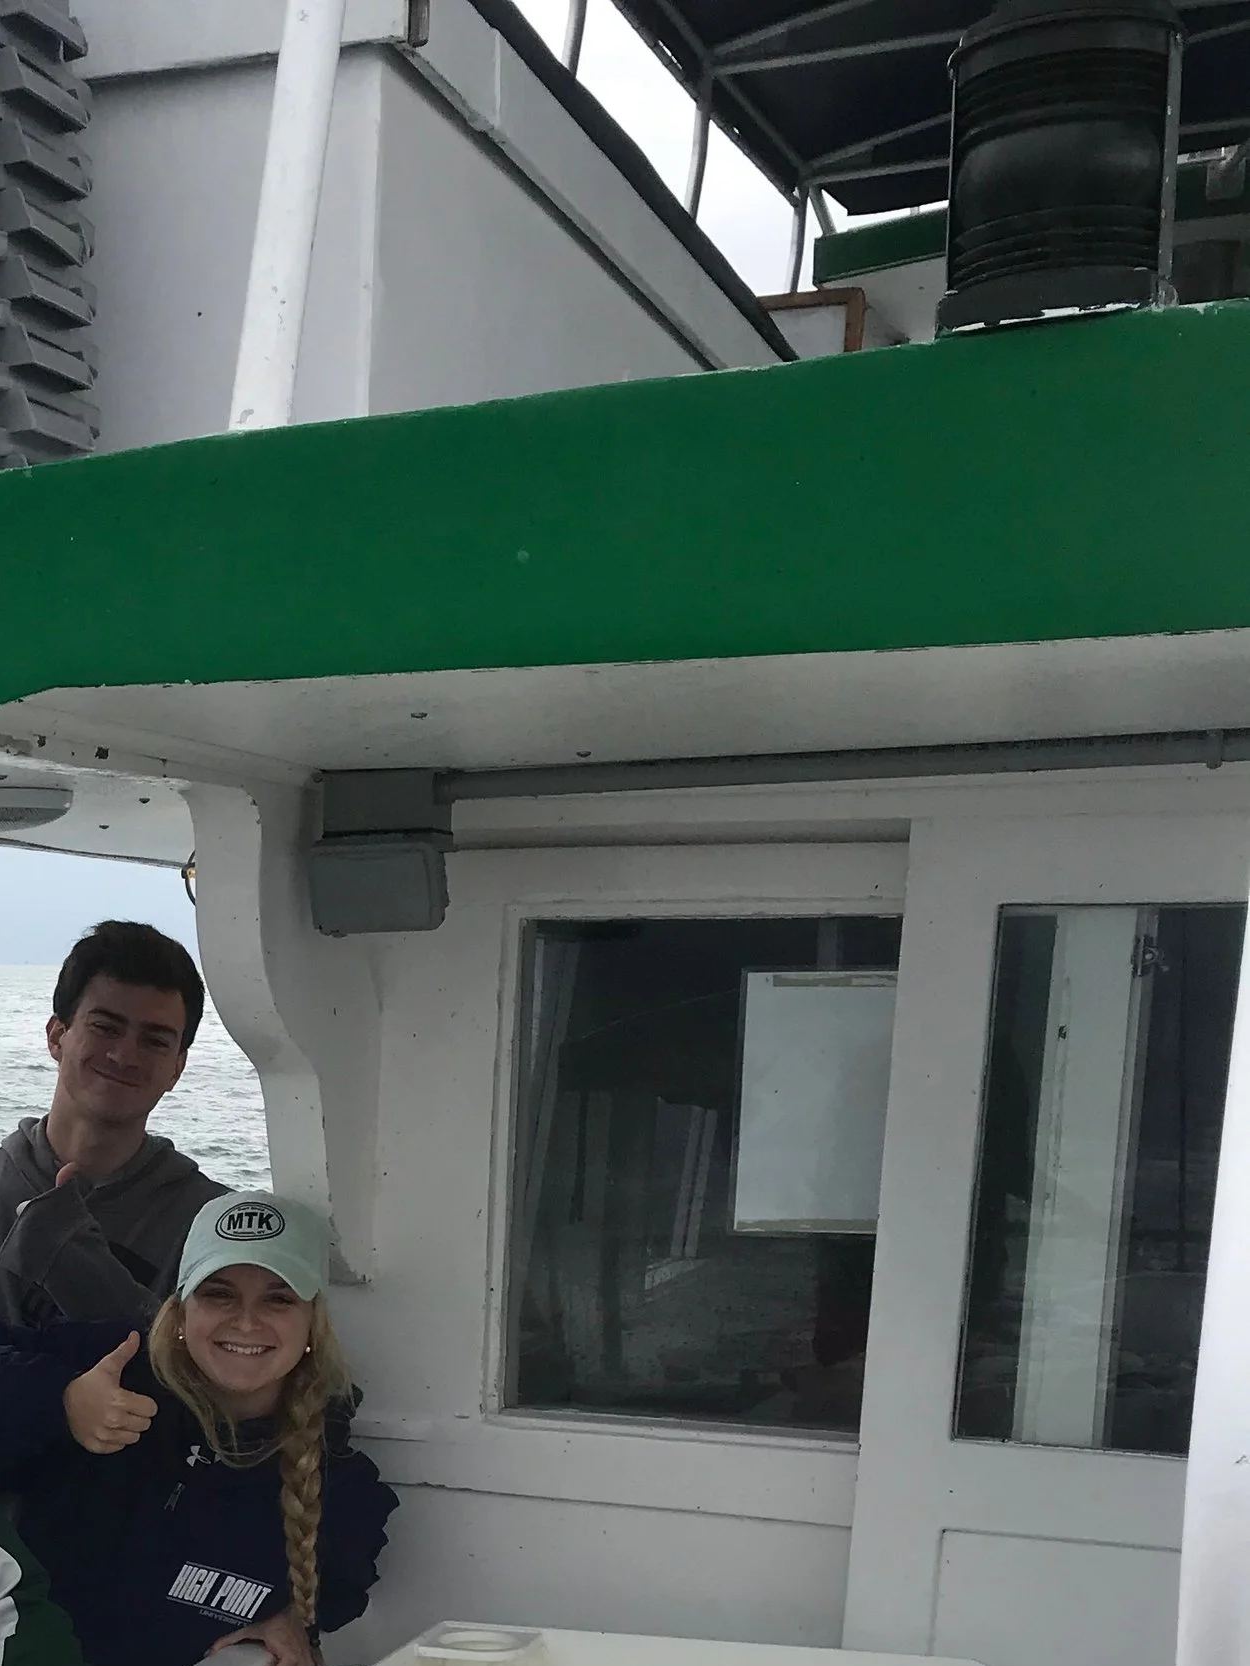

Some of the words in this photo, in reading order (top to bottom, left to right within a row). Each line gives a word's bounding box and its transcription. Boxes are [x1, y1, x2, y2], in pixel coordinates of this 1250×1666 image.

[227, 1212, 274, 1231] MTK
[168, 1564, 221, 1605] HIGH
[210, 1575, 272, 1619] POINT
